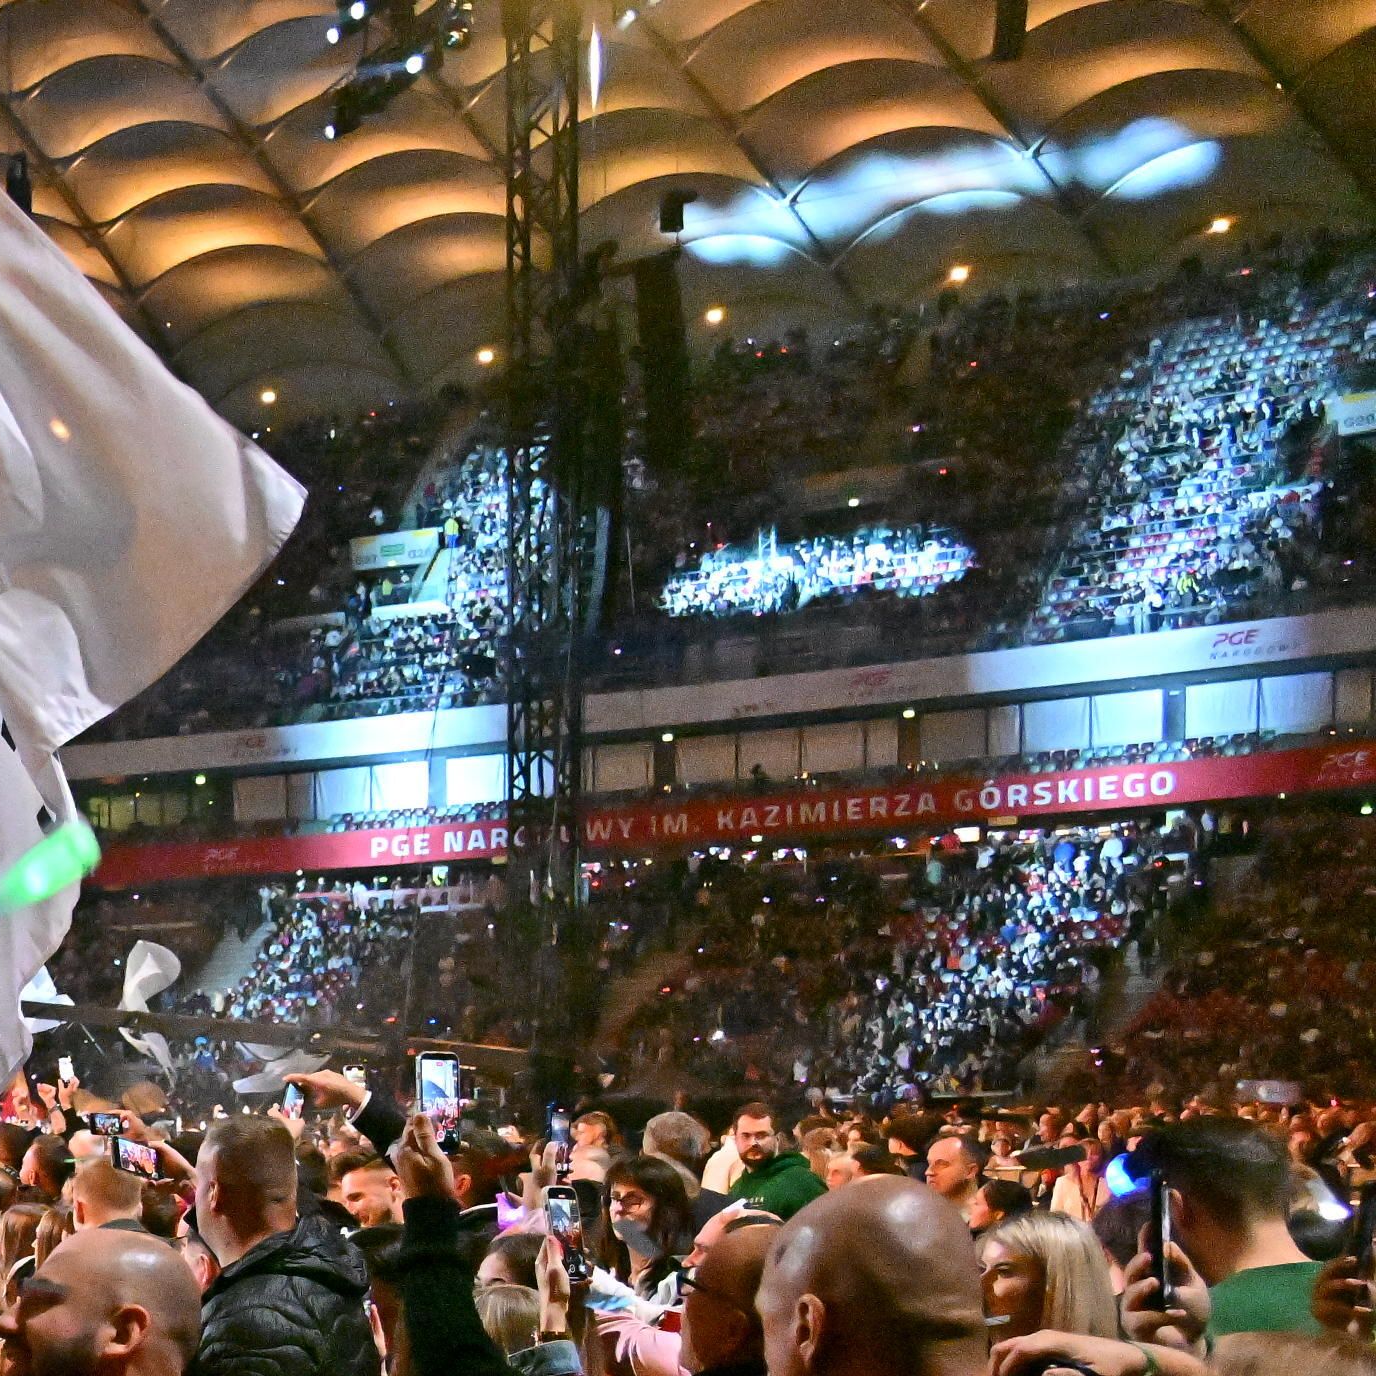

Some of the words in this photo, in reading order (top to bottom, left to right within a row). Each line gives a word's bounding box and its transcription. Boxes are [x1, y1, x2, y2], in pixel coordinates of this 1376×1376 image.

[1213, 629, 1259, 648] PGE
[370, 833, 430, 858] PGE
[444, 816, 635, 852] NARWY
[717, 792, 937, 831] KAZIMIERZA
[954, 770, 1175, 812] GÓRSKIEGO
